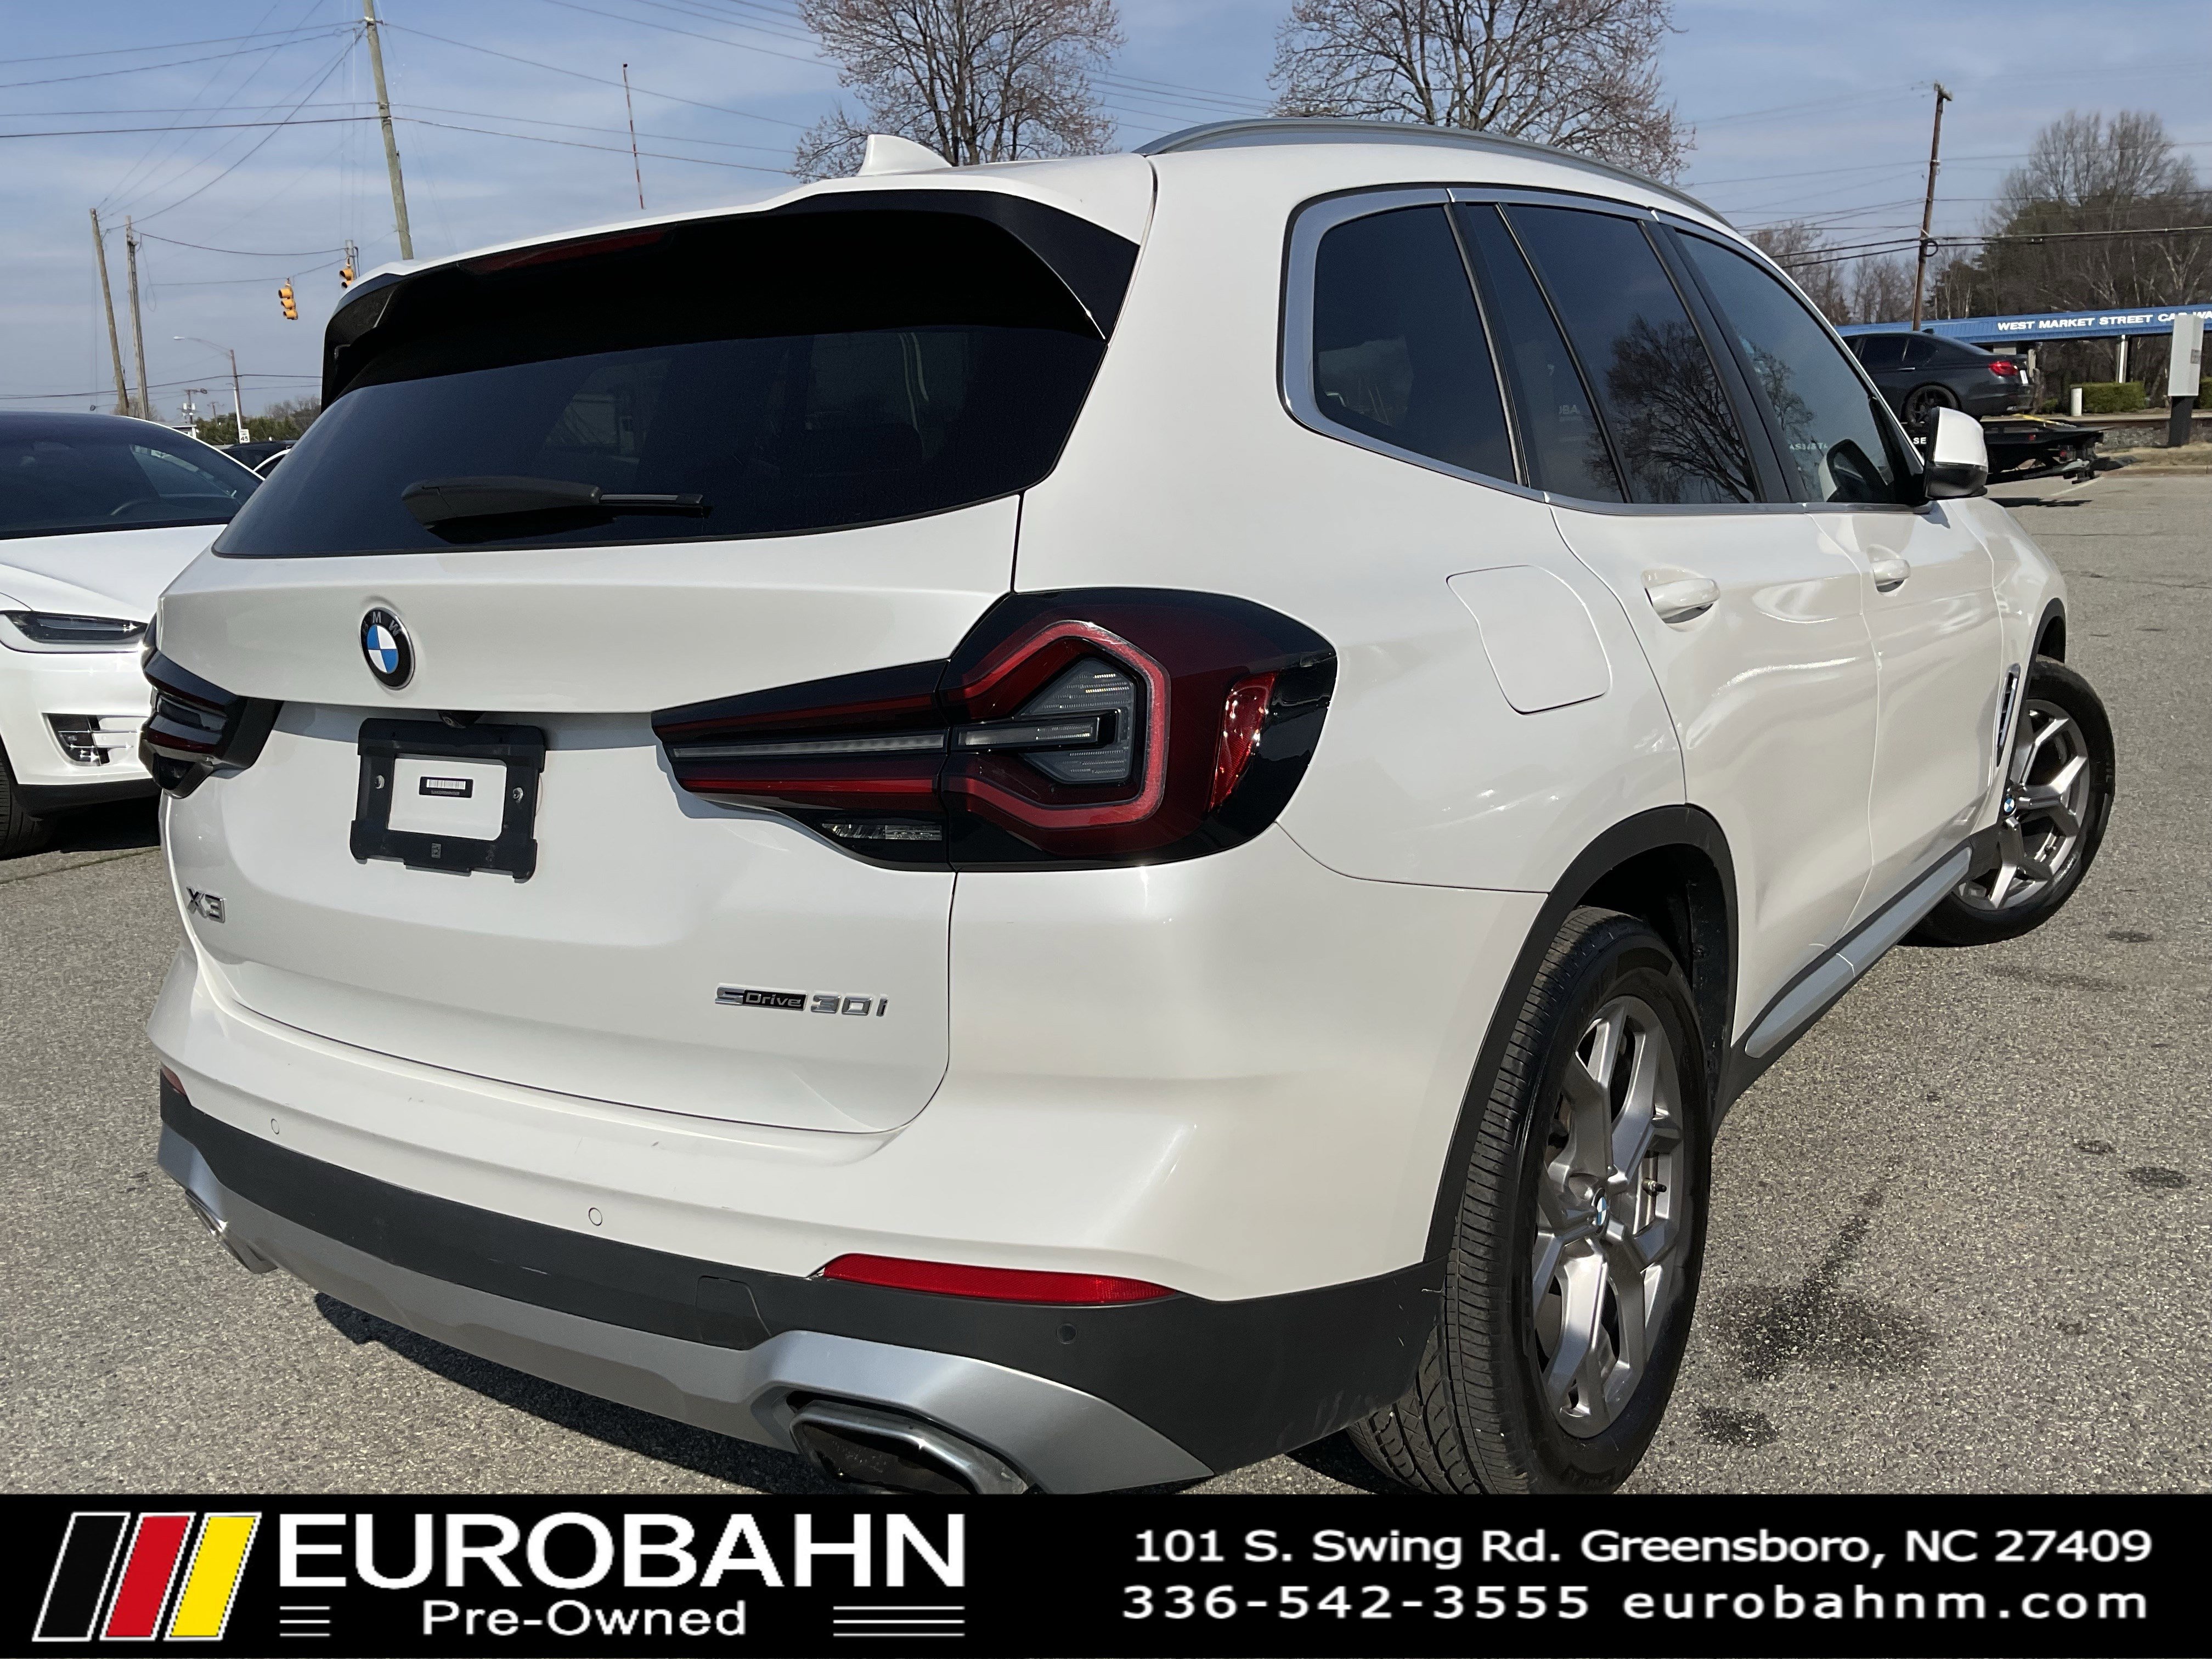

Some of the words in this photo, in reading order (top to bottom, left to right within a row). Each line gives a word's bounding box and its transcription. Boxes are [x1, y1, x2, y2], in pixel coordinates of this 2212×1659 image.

[1997, 321, 2035, 331] WEST
[2039, 318, 2095, 329] MARKET
[2099, 314, 2153, 325] STREET
[2158, 312, 2187, 322] CA
[186, 887, 225, 923] X3
